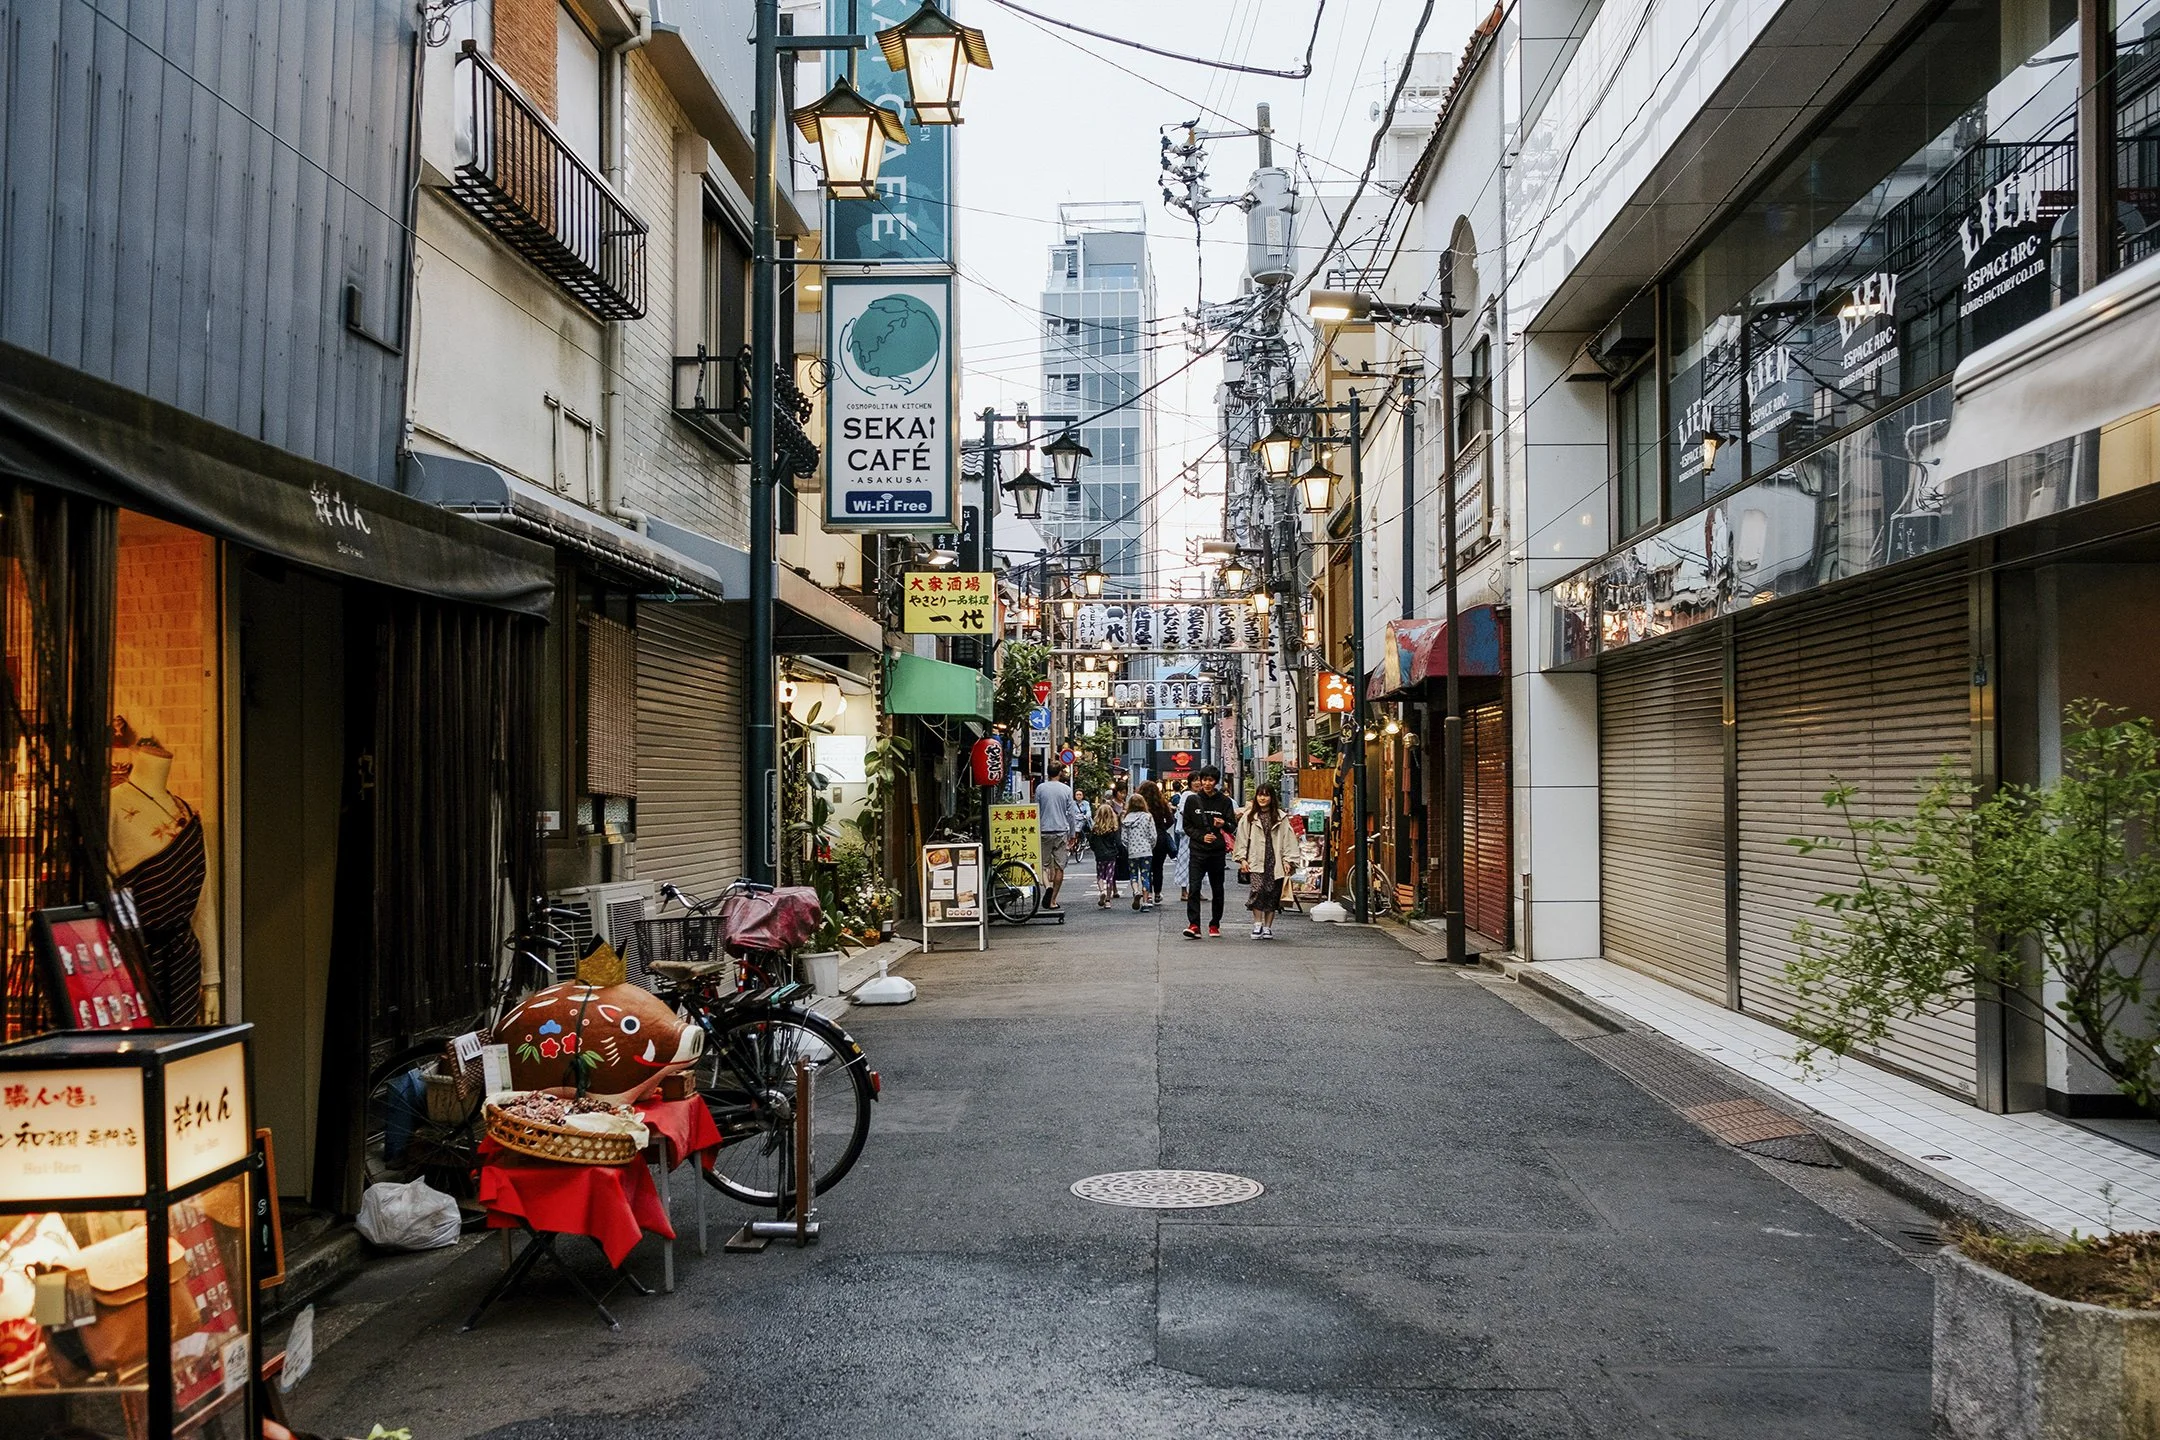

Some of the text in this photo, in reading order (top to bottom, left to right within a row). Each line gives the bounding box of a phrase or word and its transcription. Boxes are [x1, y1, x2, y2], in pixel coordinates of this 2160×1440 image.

[1958, 171, 2042, 269] LIEN
[1837, 272, 1899, 349] LIEN
[1746, 344, 1791, 407] LIEN
[846, 402, 932, 410] COSMOPOLITAN KITCHEN
[843, 416, 936, 440] SEKAI
[1678, 398, 1713, 452] LIEN
[847, 442, 931, 471] CAFÉ
[853, 500, 927, 512] Wi-Fi Free
[909, 576, 981, 592] 大衆酒場
[928, 609, 985, 629] 一代
[1134, 608, 1153, 645] 花月堂
[992, 809, 1037, 822] 大衆酒場
